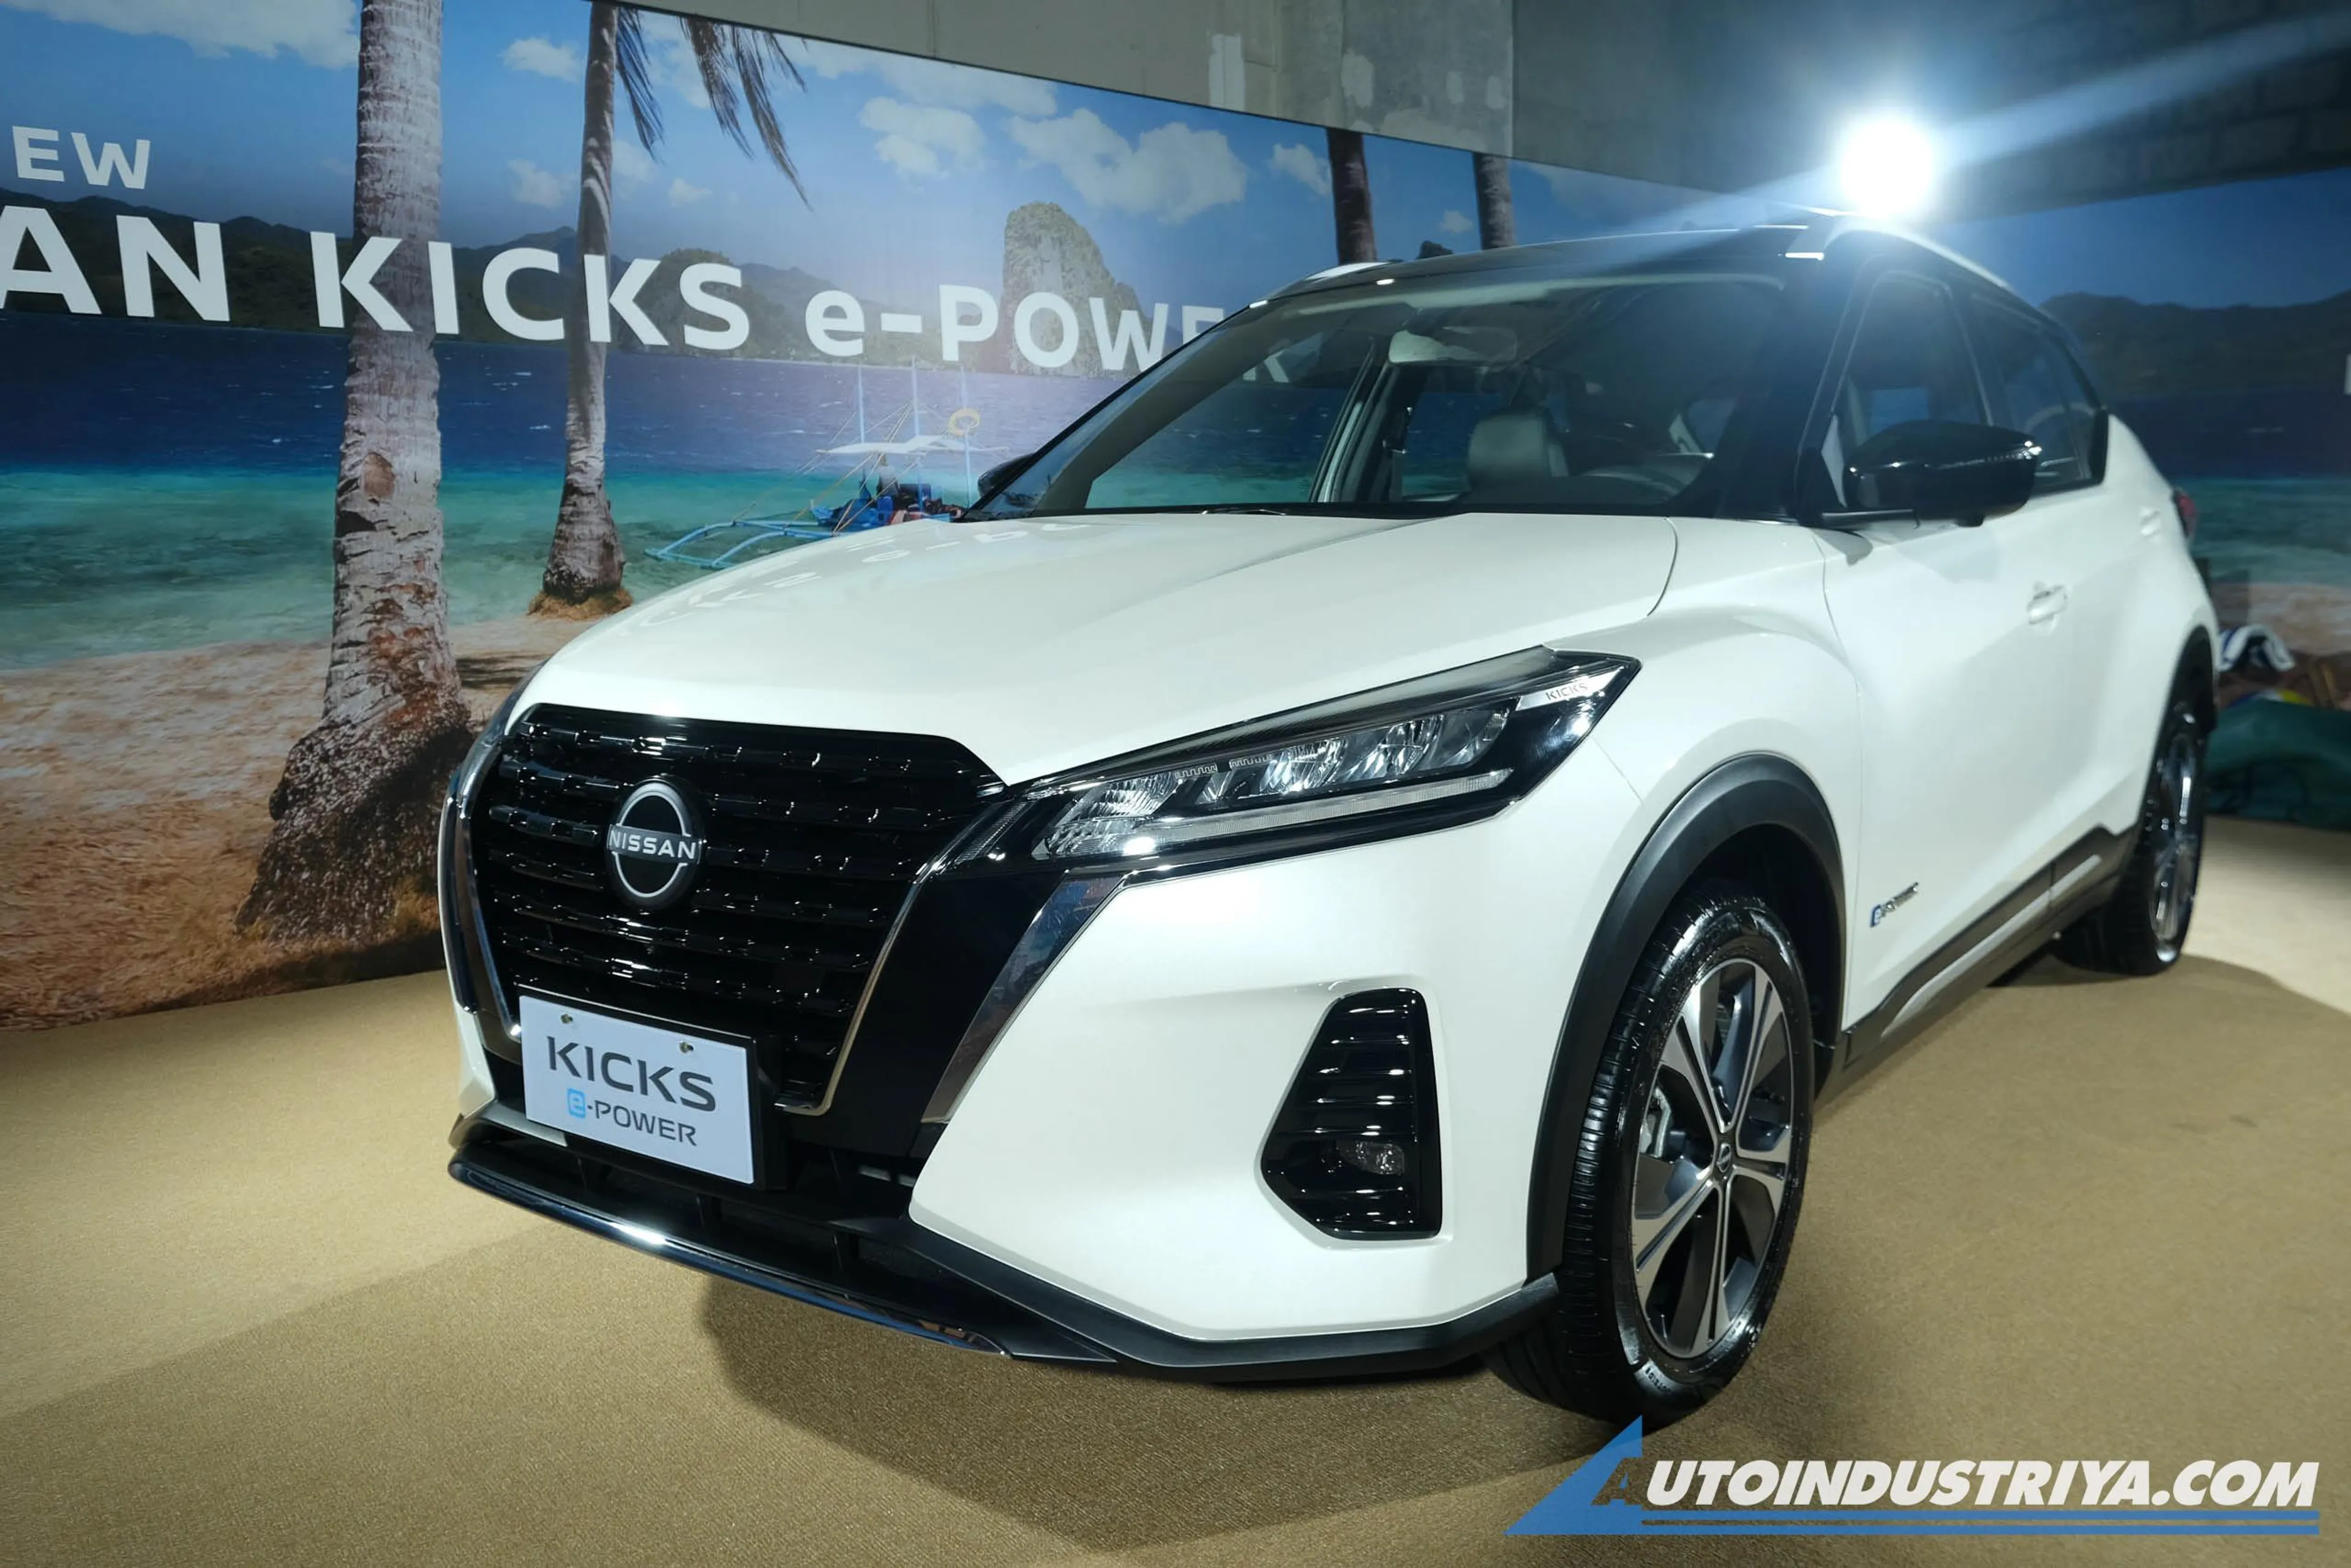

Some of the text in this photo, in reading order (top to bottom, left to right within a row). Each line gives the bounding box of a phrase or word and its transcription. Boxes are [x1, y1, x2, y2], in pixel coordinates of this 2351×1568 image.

[310, 231, 750, 351] KICKS
[1545, 683, 1588, 700] KICKS
[609, 830, 697, 860] NISSAN
[547, 1036, 716, 1112] KICKS
